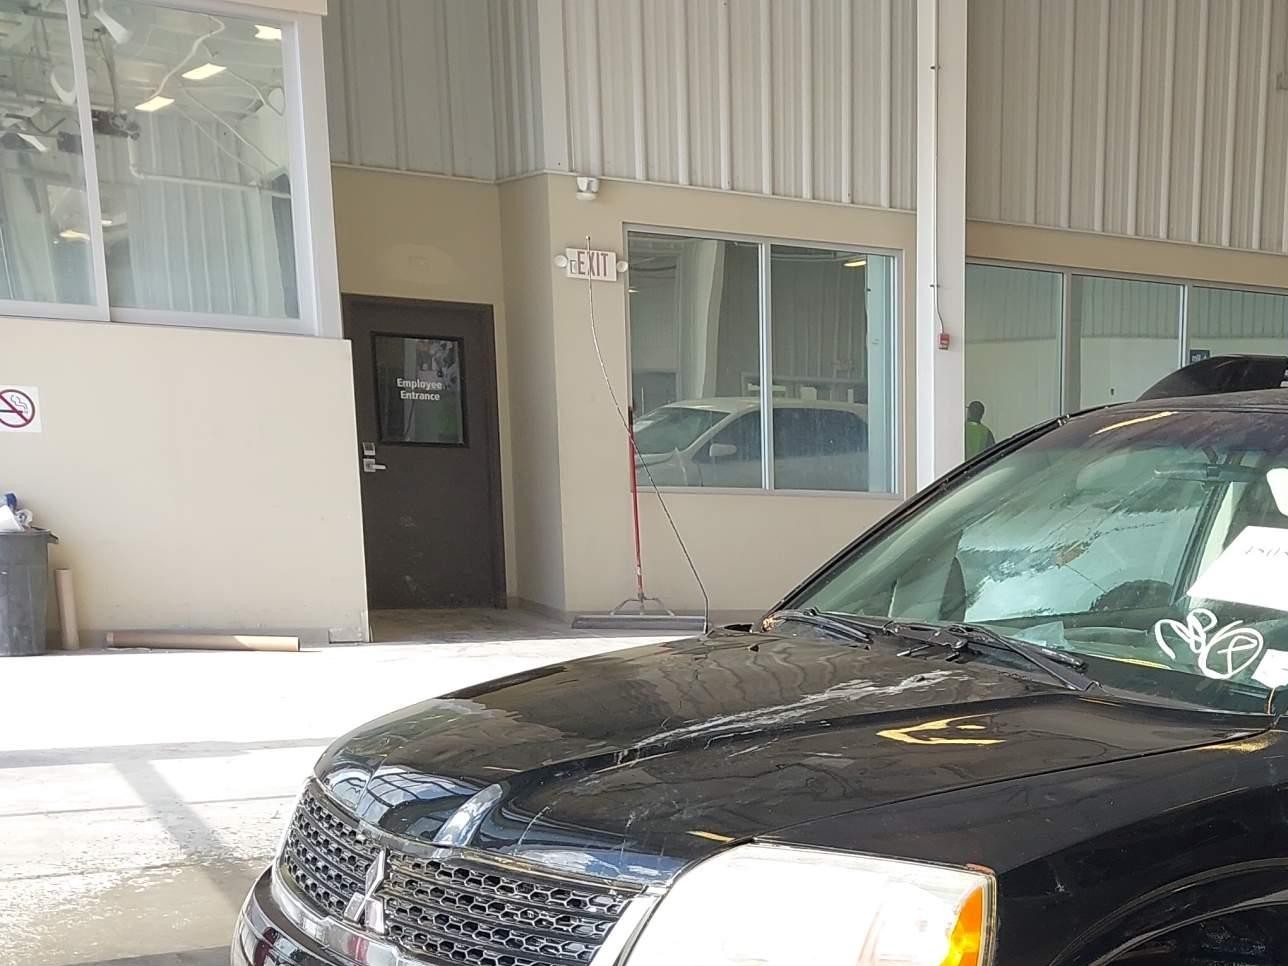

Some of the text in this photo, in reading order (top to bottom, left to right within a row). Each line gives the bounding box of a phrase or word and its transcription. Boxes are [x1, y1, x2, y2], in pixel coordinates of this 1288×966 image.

[577, 250, 608, 277] EXIT
[396, 378, 443, 390] Employee
[400, 390, 440, 401] Entrance
